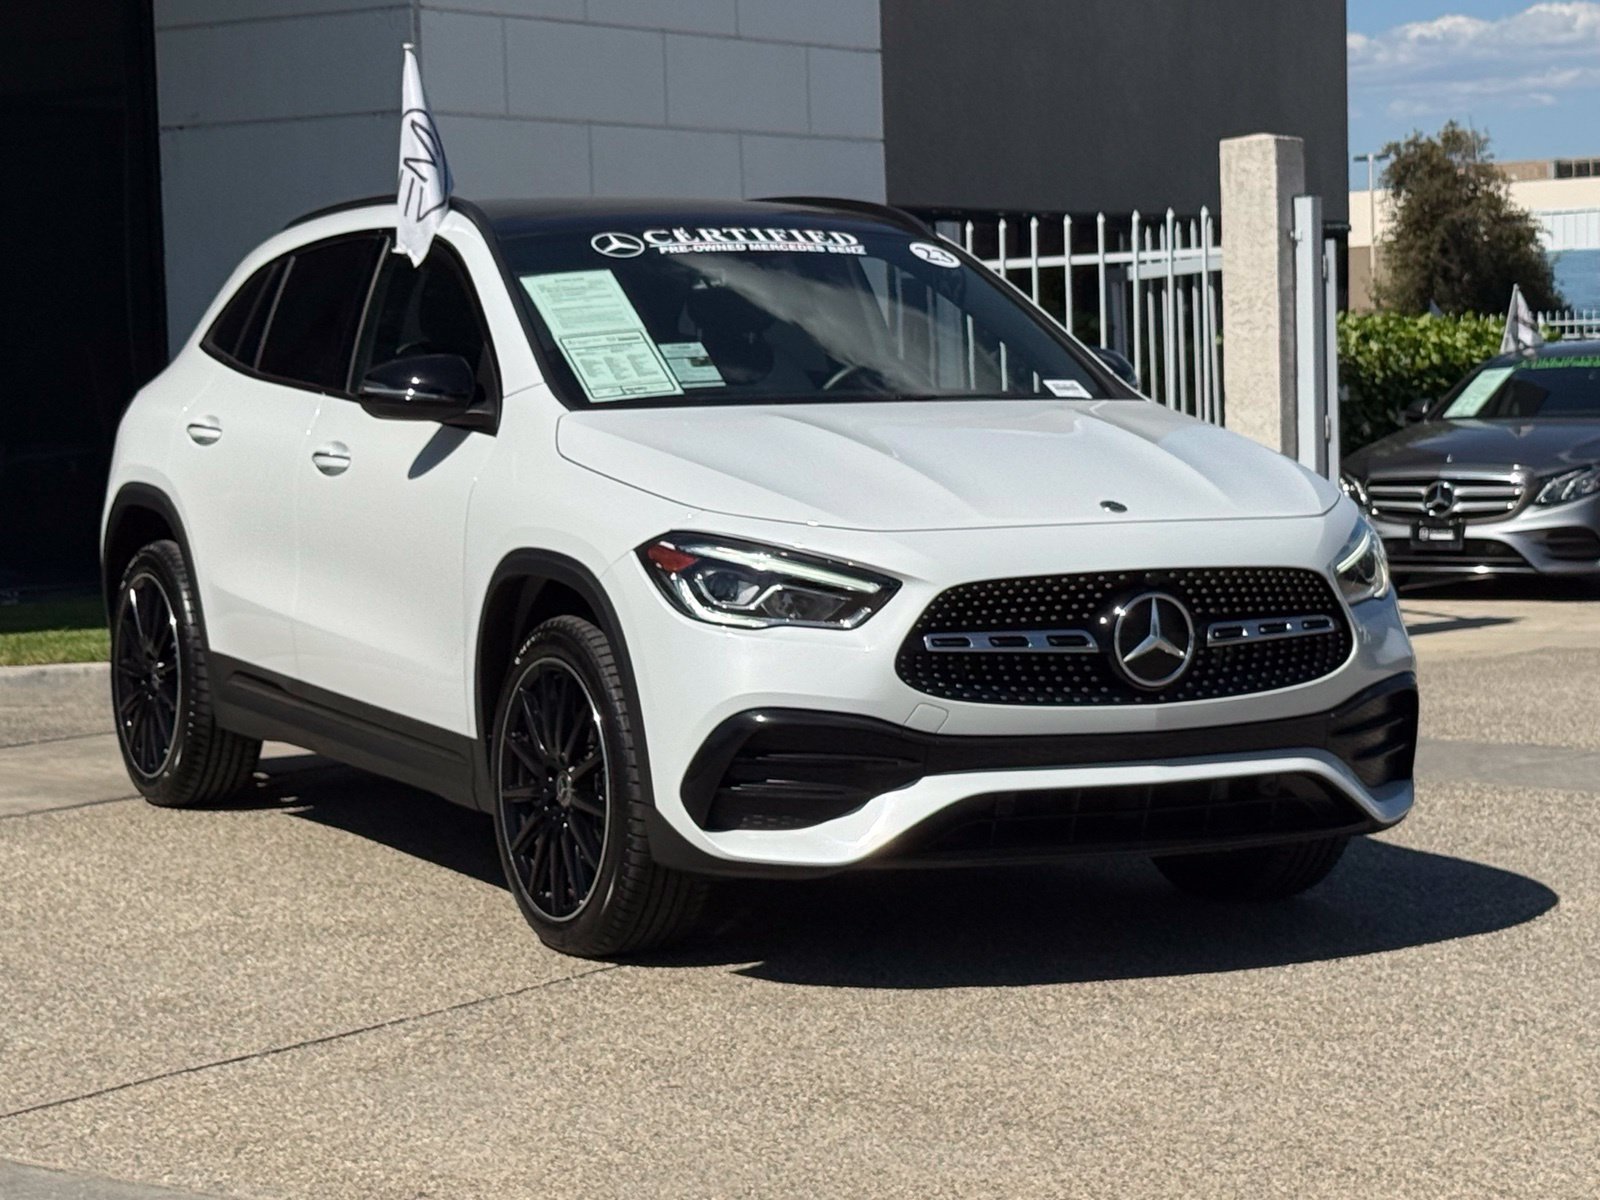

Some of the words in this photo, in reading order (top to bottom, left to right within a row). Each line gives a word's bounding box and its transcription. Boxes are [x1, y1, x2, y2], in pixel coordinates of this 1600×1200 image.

[643, 227, 859, 246] CERTIFIED
[659, 243, 747, 254] PRE-OWNED
[749, 243, 825, 253] MERCEDES
